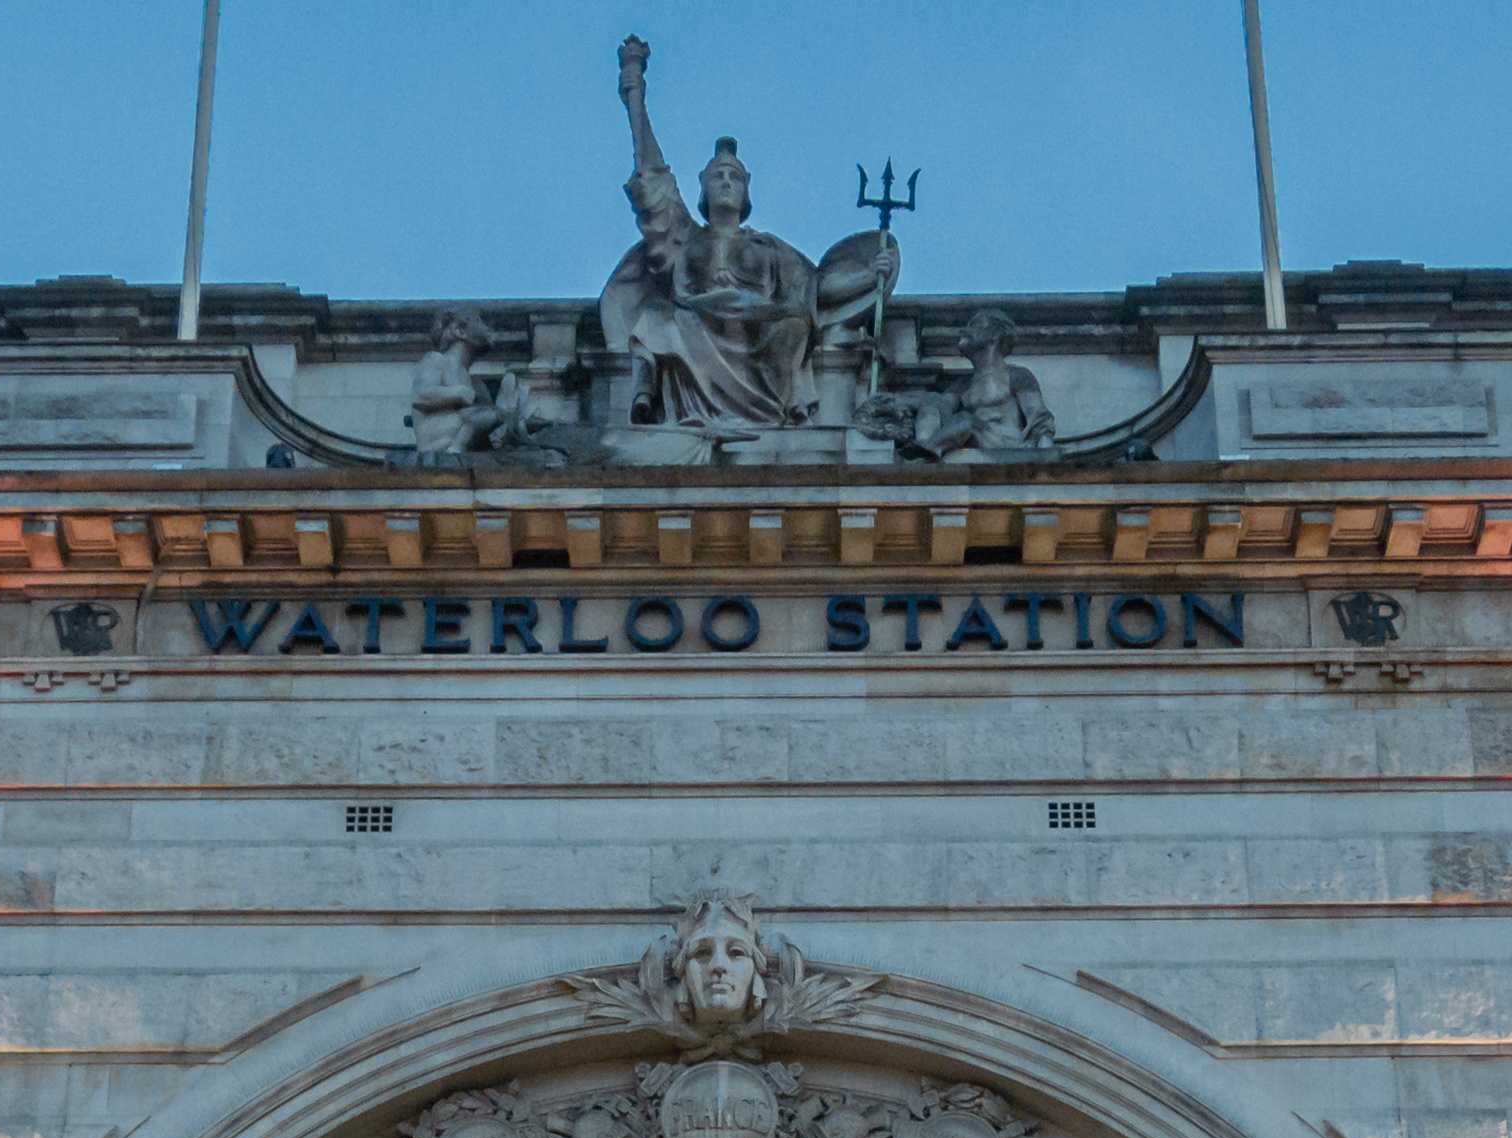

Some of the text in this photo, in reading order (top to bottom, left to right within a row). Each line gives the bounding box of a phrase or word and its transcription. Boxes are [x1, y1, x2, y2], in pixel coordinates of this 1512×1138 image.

[189, 592, 1246, 656] WATERLOO STATION
[670, 1096, 769, 1137] FRANCE
